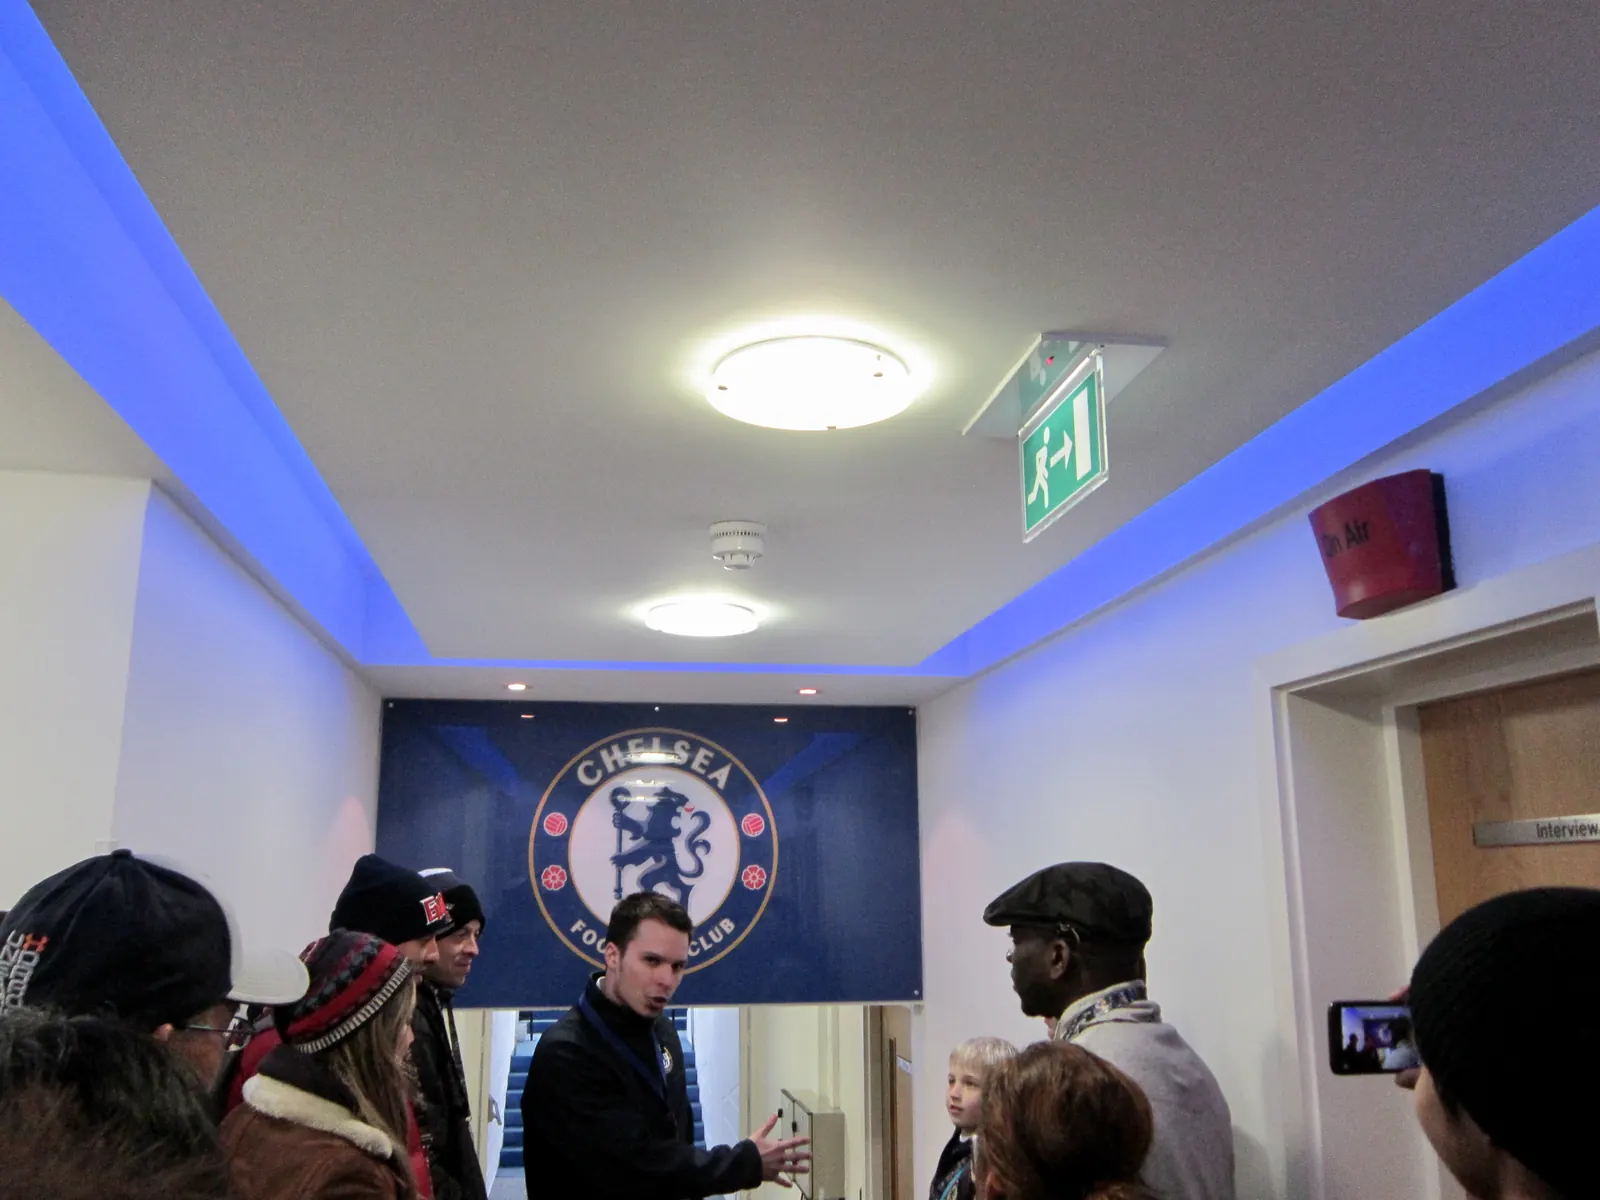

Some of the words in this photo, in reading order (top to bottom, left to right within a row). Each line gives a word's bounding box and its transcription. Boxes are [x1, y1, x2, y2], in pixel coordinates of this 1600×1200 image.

[1344, 519, 1369, 549] Air
[577, 736, 732, 790] CHELSEA
[1537, 820, 1600, 839] Interview
[688, 918, 735, 956] CLUB
